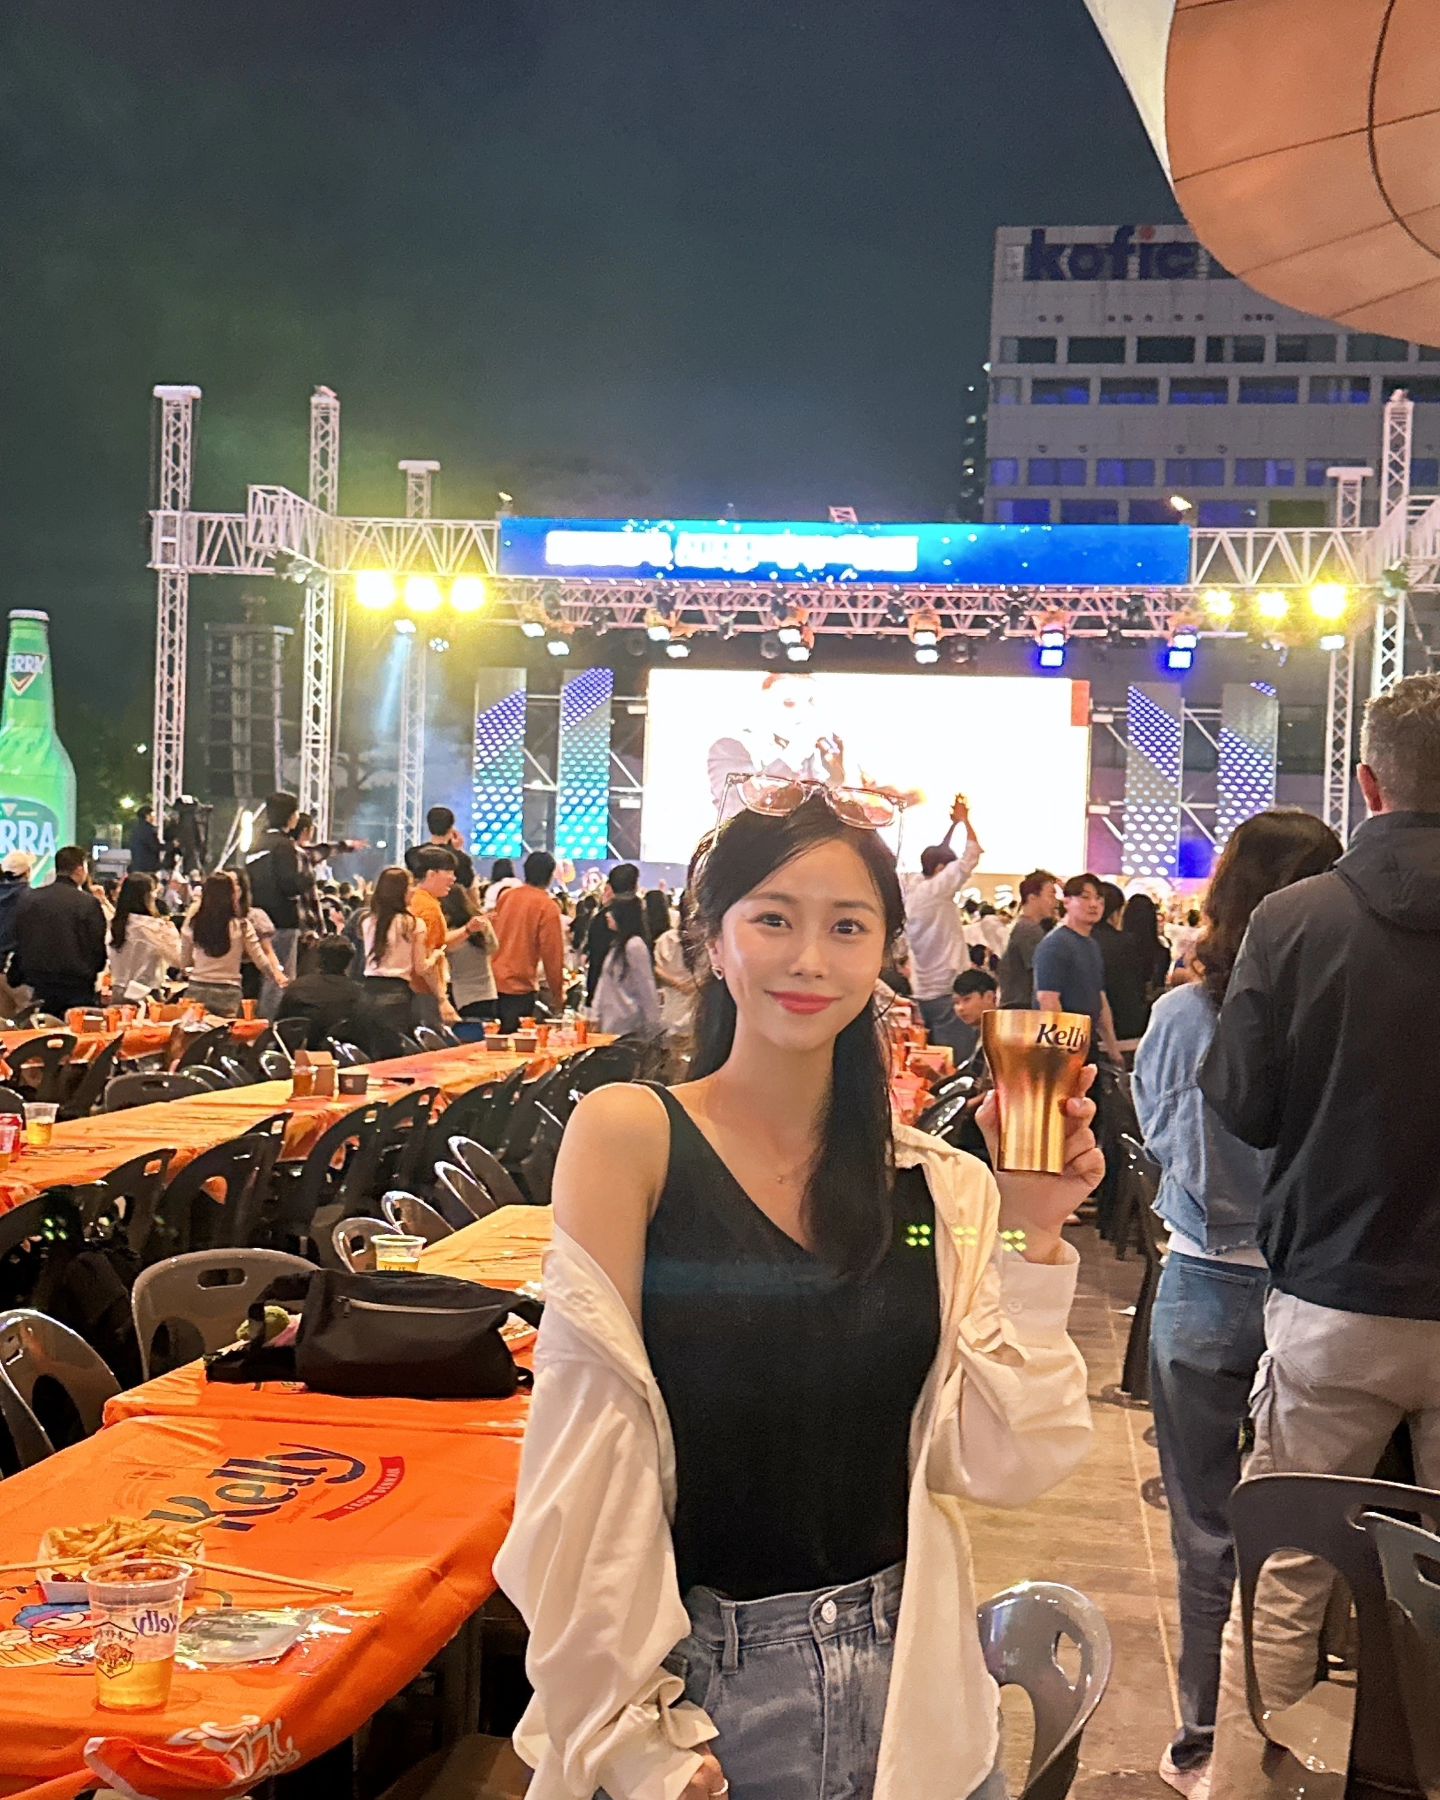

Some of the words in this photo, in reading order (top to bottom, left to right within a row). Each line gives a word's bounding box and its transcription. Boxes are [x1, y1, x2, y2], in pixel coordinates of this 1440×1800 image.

[1031, 225, 1199, 280] kofic
[1036, 1023, 1088, 1054] Kelly
[142, 1442, 366, 1532] Kelly
